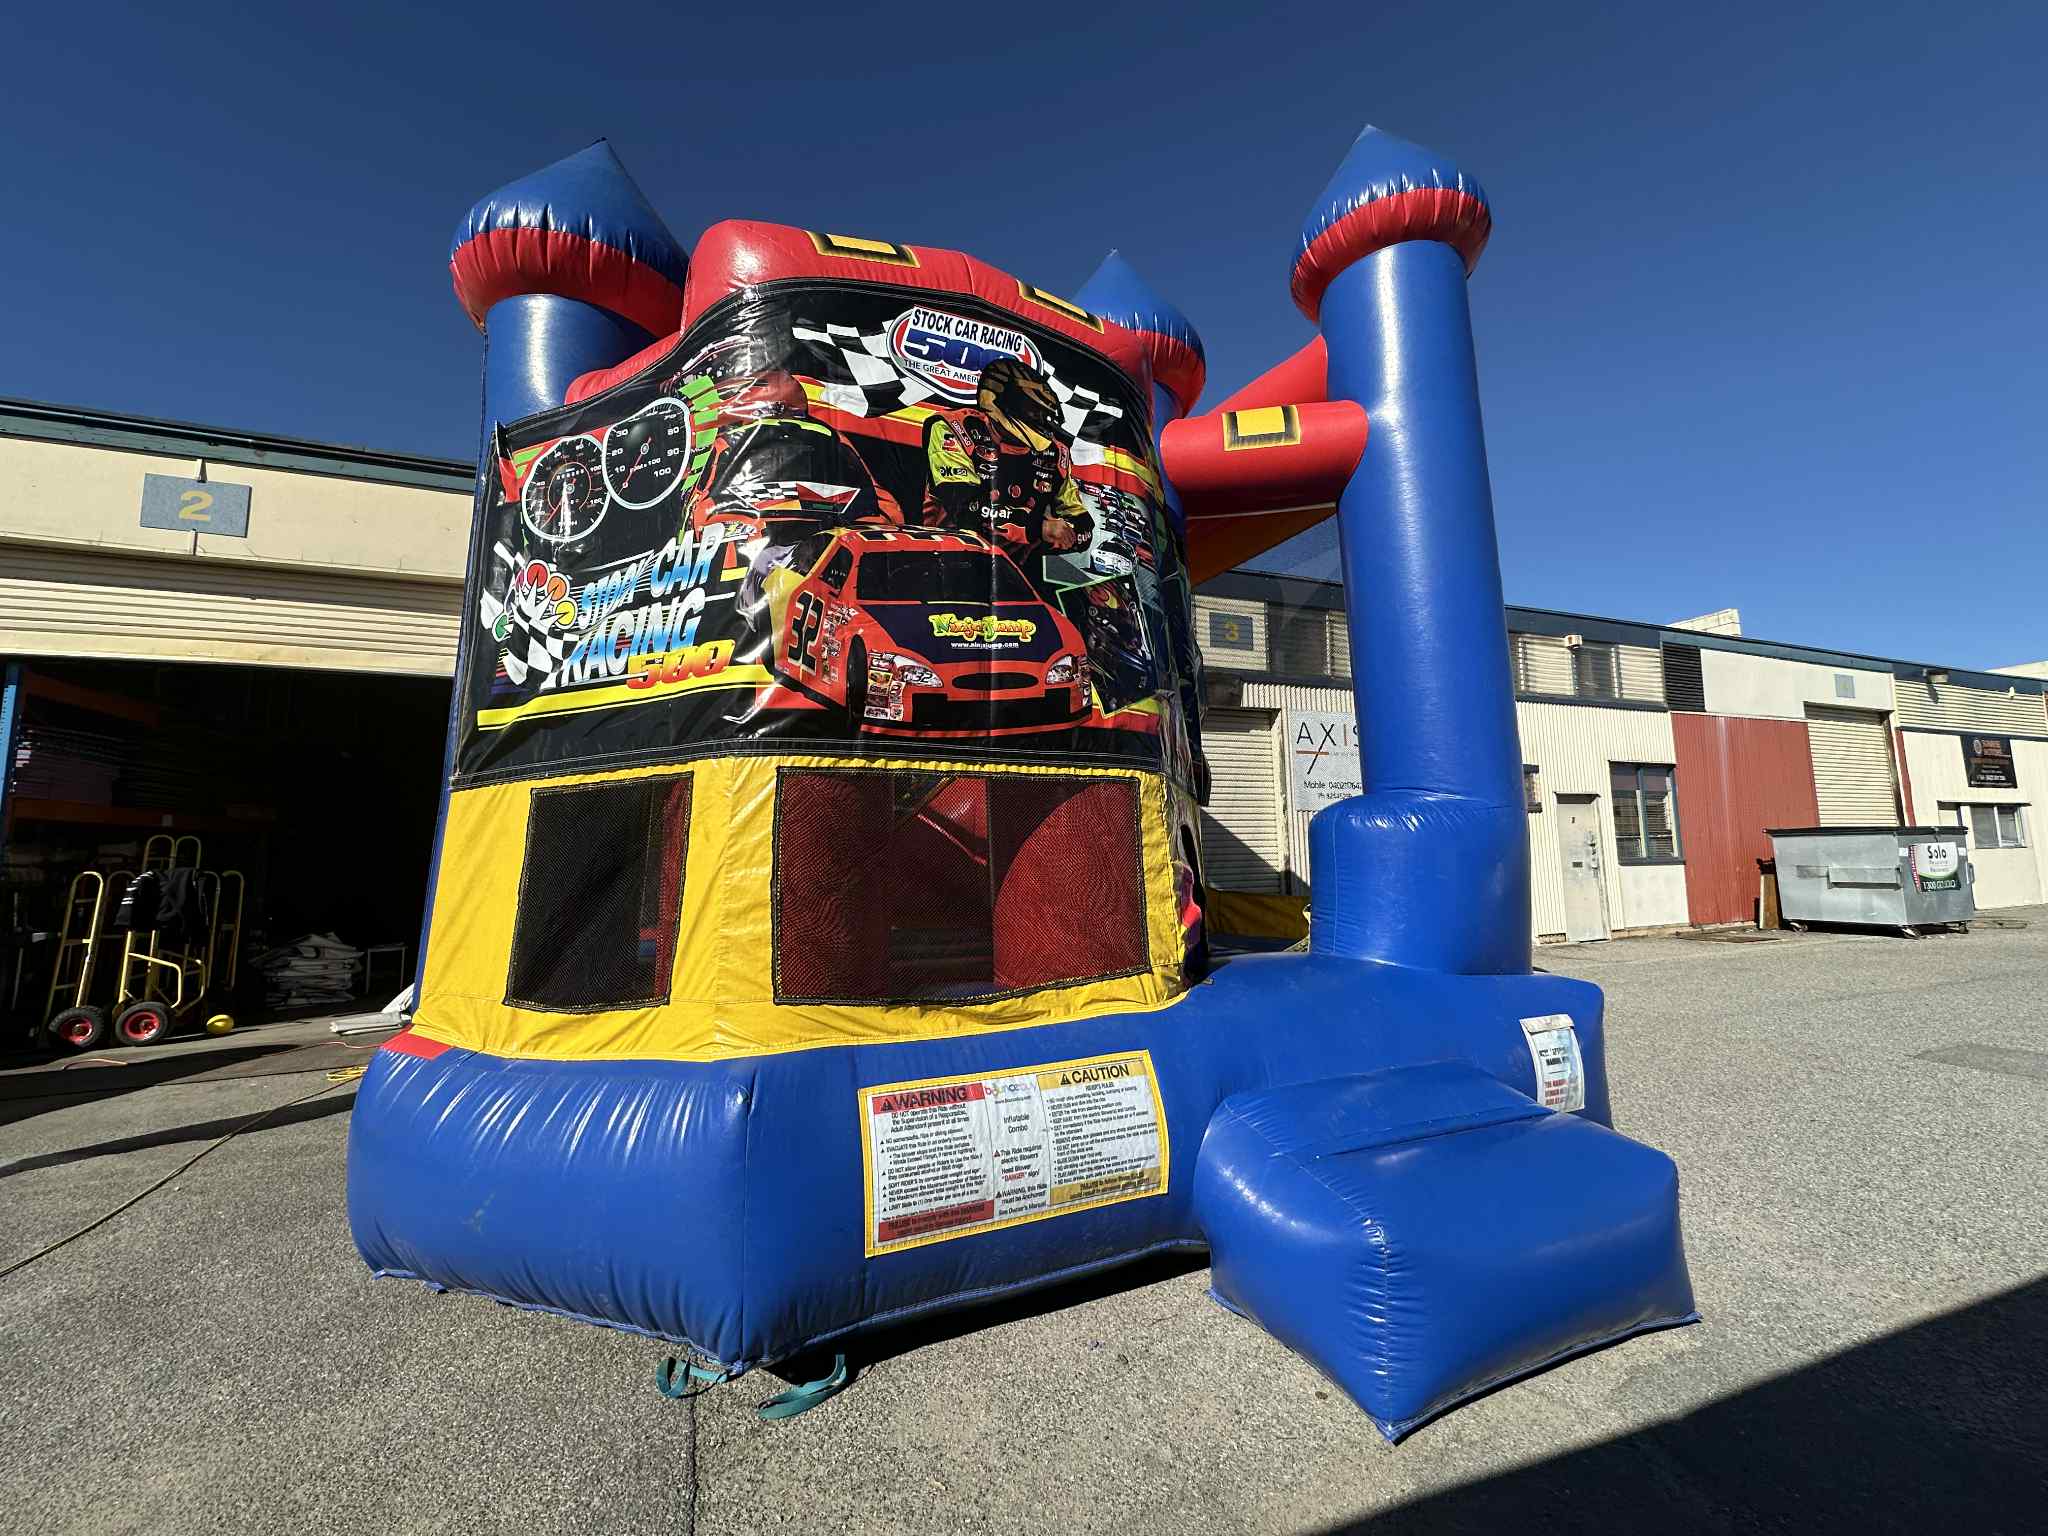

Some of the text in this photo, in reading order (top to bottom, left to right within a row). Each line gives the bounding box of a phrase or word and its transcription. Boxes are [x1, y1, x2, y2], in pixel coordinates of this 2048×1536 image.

[912, 308, 1023, 352] STOCK CAR RACING
[904, 358, 980, 384] THE GREAT AMERI
[616, 429, 629, 437] 30
[667, 426, 680, 435] 80
[611, 448, 623, 456] 20
[666, 448, 680, 456] 90
[614, 465, 626, 473] 10
[653, 467, 671, 477] 100
[179, 490, 213, 521] 2
[650, 523, 726, 598] CAR
[561, 587, 706, 688] RACING
[787, 590, 825, 676] 32
[1224, 623, 1239, 641] 3
[626, 639, 736, 689] 500
[1927, 844, 1947, 859] Solo
[1071, 1063, 1130, 1084] CAUTION
[894, 1087, 968, 1109] WARNING
